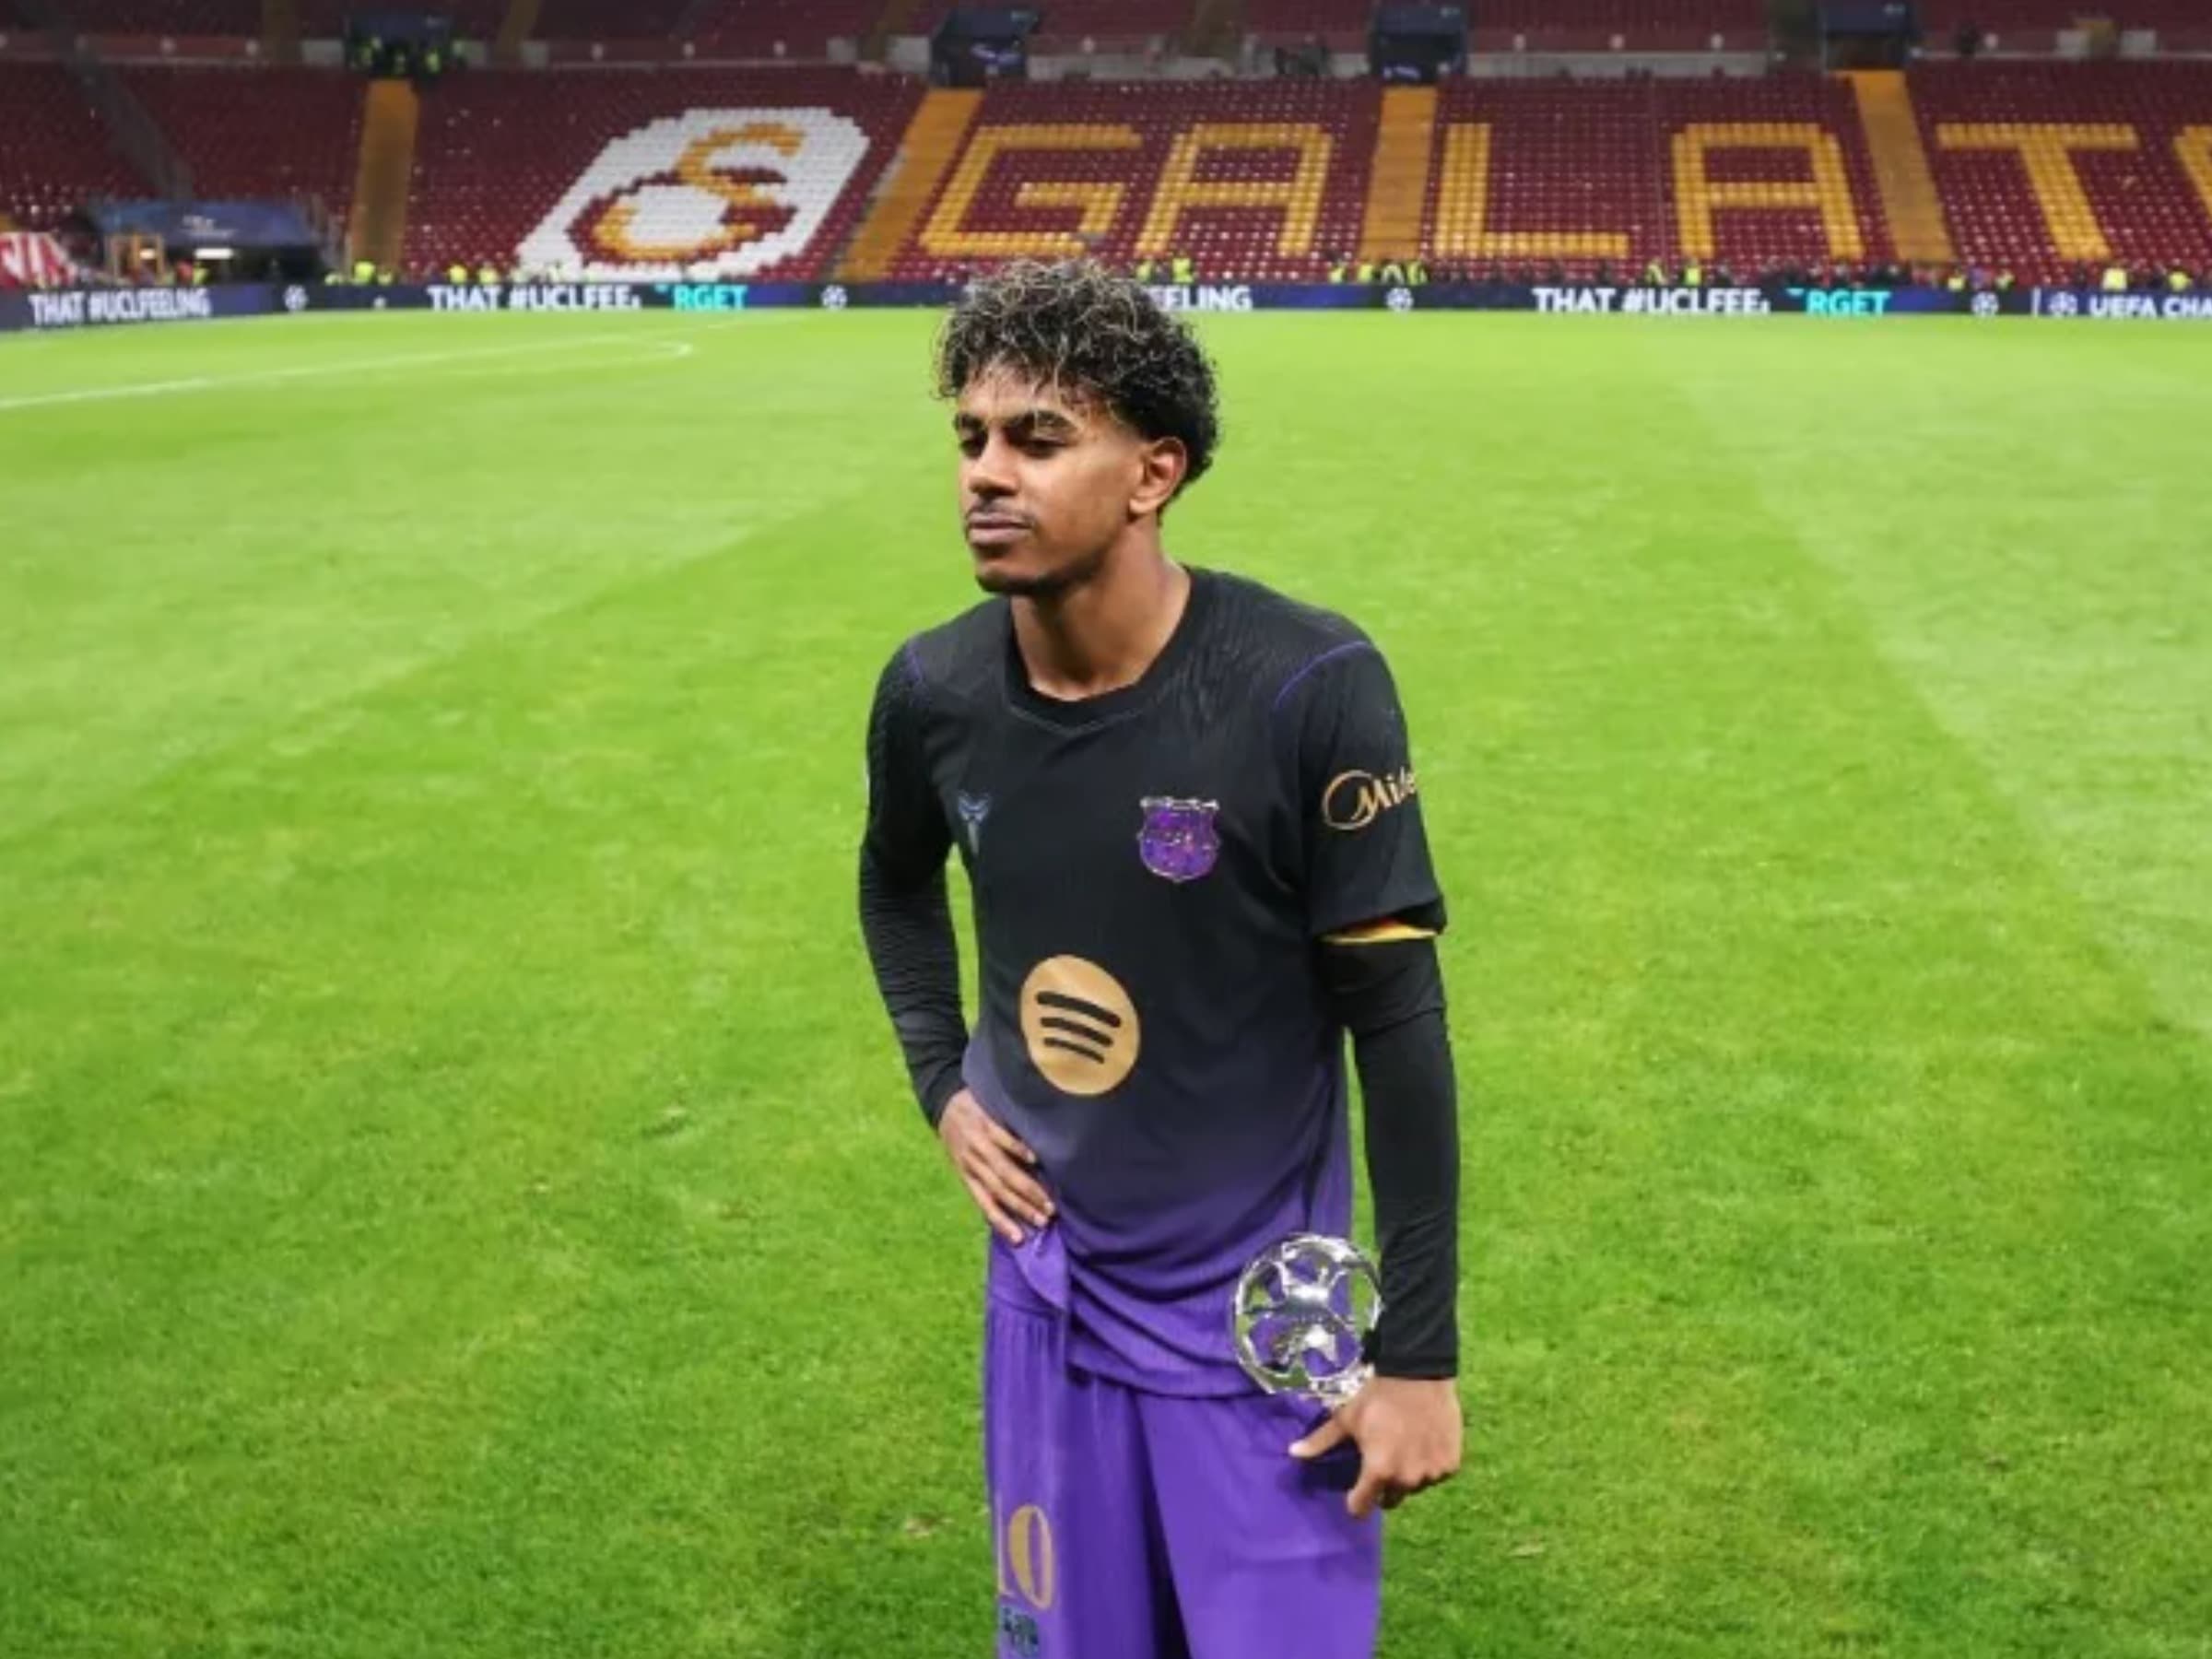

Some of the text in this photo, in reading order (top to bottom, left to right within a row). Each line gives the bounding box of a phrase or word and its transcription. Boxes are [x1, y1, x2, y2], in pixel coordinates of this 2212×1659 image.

[29, 291, 84, 325] THAT
[427, 284, 501, 310] THAT
[654, 284, 748, 311] RGET
[1532, 288, 1617, 312] THAT
[1785, 288, 1891, 314] RGET
[2089, 294, 2158, 317] UEFA
